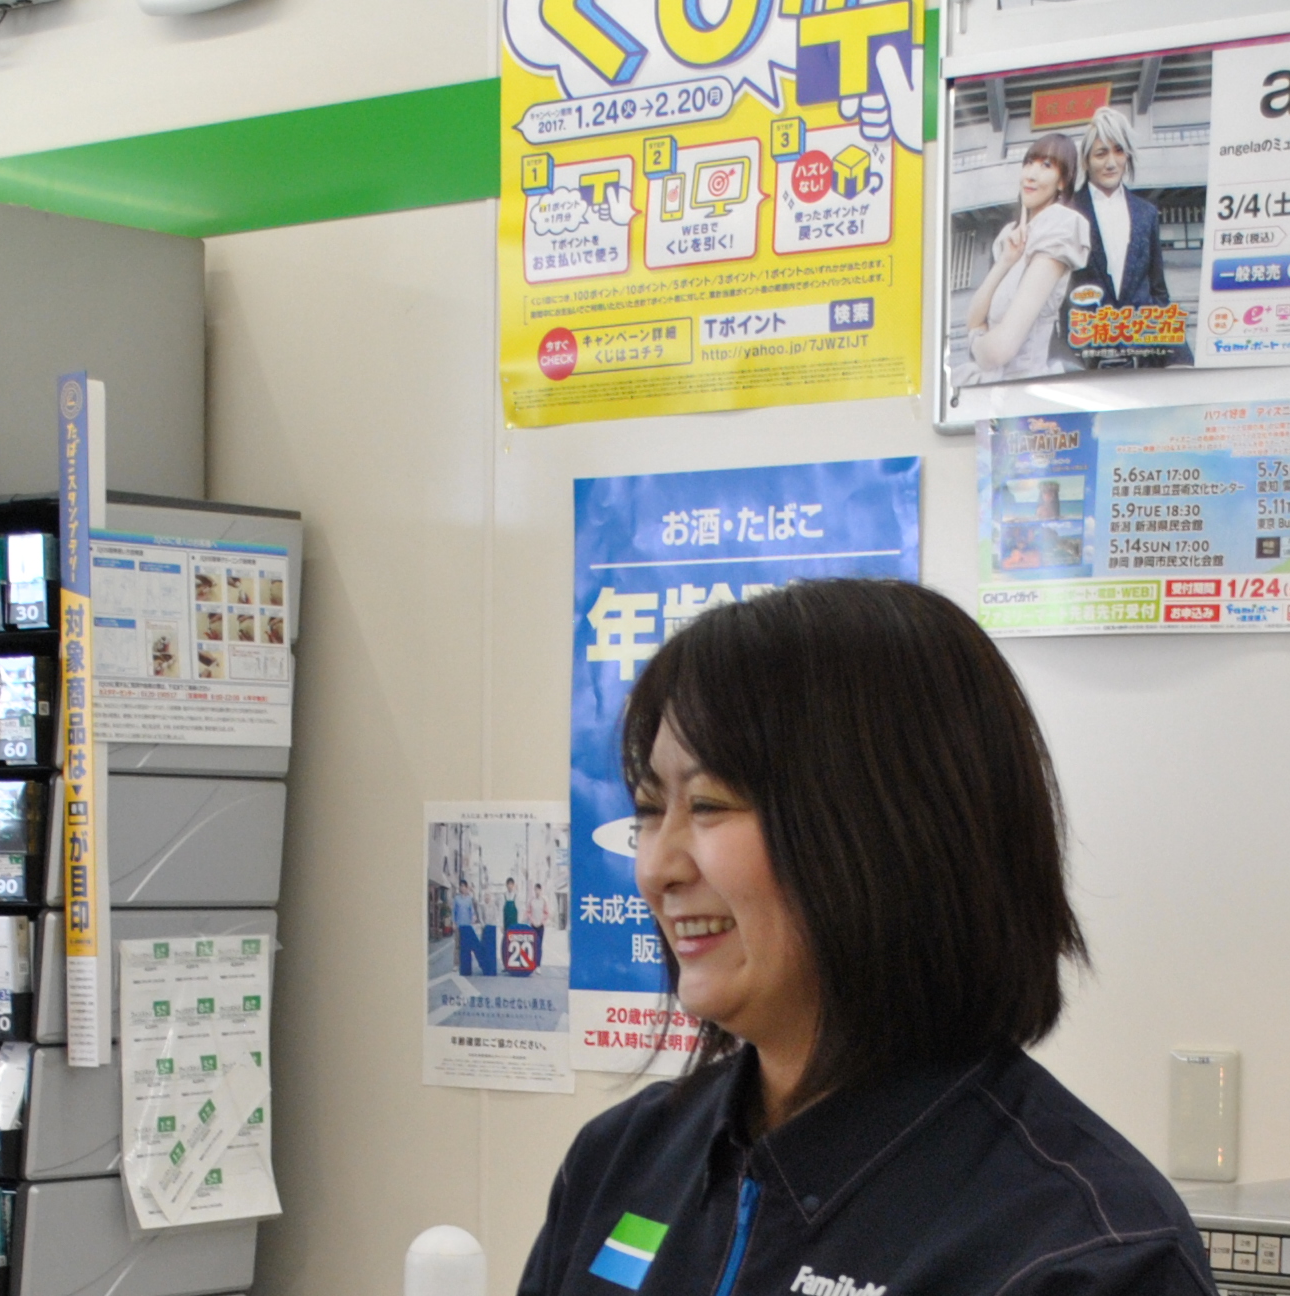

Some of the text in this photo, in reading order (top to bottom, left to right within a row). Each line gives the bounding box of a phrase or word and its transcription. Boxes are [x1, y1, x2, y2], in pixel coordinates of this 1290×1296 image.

[795, 162, 829, 178] ハズレ
[799, 178, 824, 193] なし!
[795, 204, 869, 223] 使ったポイントが
[682, 223, 718, 236] WEBで
[799, 220, 864, 241] 戻ってくる!
[551, 236, 599, 250] Tポイントを
[666, 235, 734, 255] くじを引く!
[533, 247, 619, 271] お支払いで使う
[1219, 264, 1281, 283] 一般発売
[704, 303, 871, 339] Tポイント 検索
[582, 325, 677, 348] キャンペーン詳細
[540, 354, 575, 366] CHECK
[594, 345, 665, 364] くじはコチラ
[1167, 468, 1200, 481] 17:00
[1133, 483, 1245, 497] 兵庫県立芸術文化センター
[66, 422, 81, 584] たばこスタンプラリー
[1166, 504, 1200, 517] 18:30
[662, 504, 824, 546] お酒・たばこ
[1135, 520, 1203, 532] 新潟県民会館
[1175, 540, 1209, 552] 17:00
[1134, 555, 1224, 568] 静岡市民文化会館
[1171, 582, 1214, 595] 受付期間
[17, 606, 38, 621] 30
[1171, 607, 1213, 619] お申込み
[5, 743, 26, 757] 60
[69, 831, 89, 933] が目印
[508, 942, 534, 968] 20
